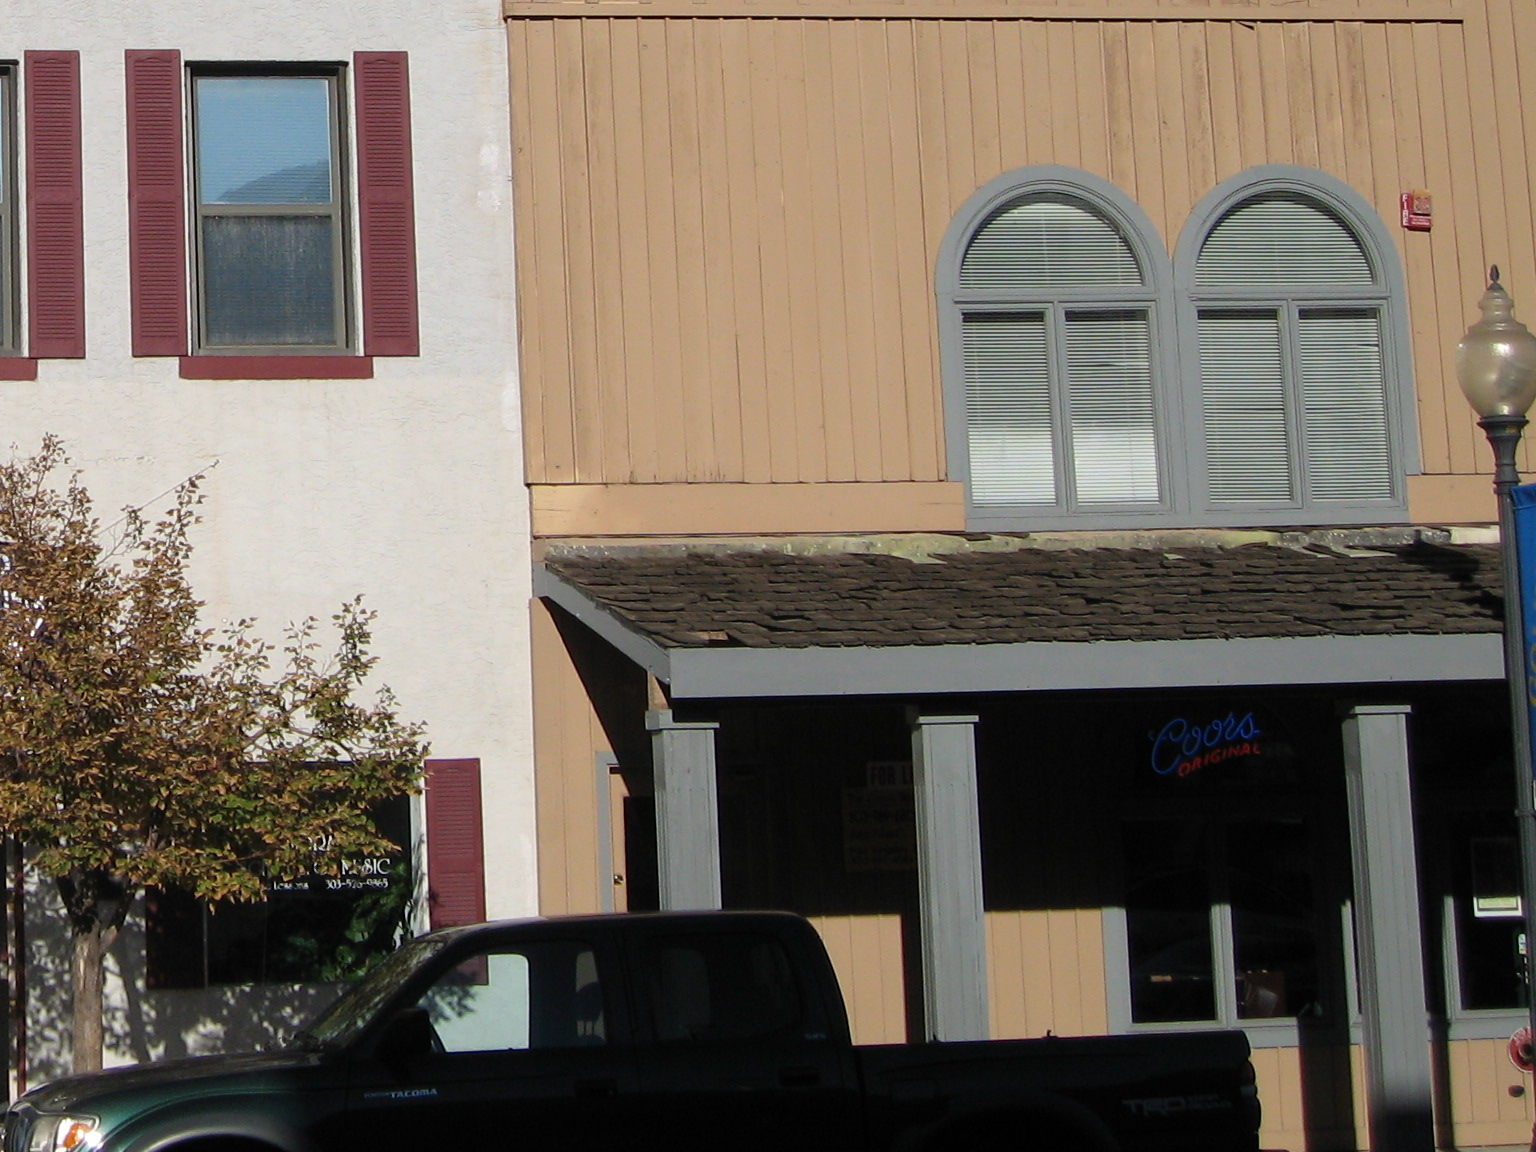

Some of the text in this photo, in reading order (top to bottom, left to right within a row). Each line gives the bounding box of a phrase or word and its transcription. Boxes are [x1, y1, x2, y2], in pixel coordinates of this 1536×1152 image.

[1148, 711, 1263, 775] Coors
[1176, 743, 1261, 776] ORIGINAL
[870, 764, 897, 786] FOR
[341, 857, 391, 876] MSIC
[391, 1088, 438, 1098] TACOMA
[1121, 1097, 1186, 1117] TRD
